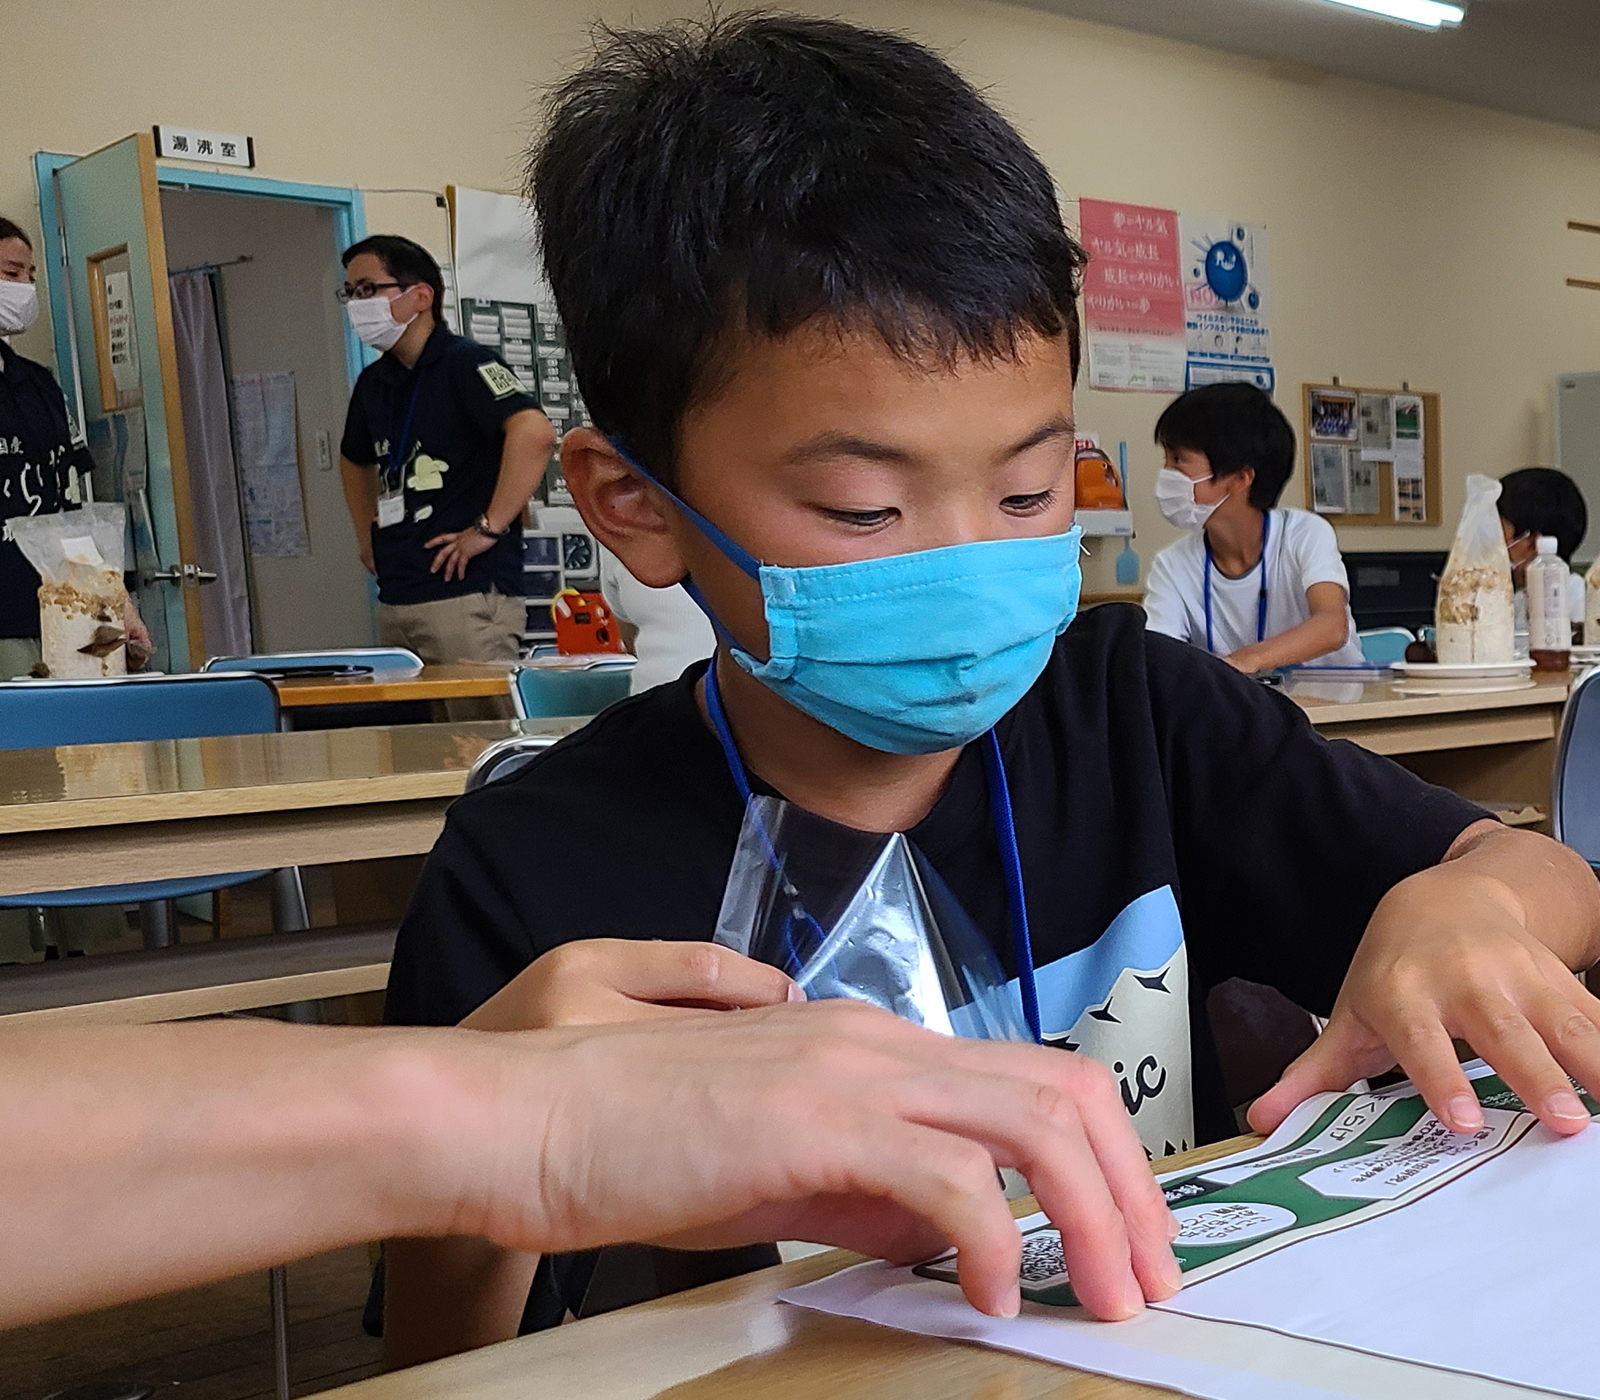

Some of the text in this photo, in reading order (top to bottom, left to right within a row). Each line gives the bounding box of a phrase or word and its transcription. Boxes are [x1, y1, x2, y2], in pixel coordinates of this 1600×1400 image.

[171, 134, 237, 158] 湯沸室
[1205, 1216, 1273, 1239] ここから
